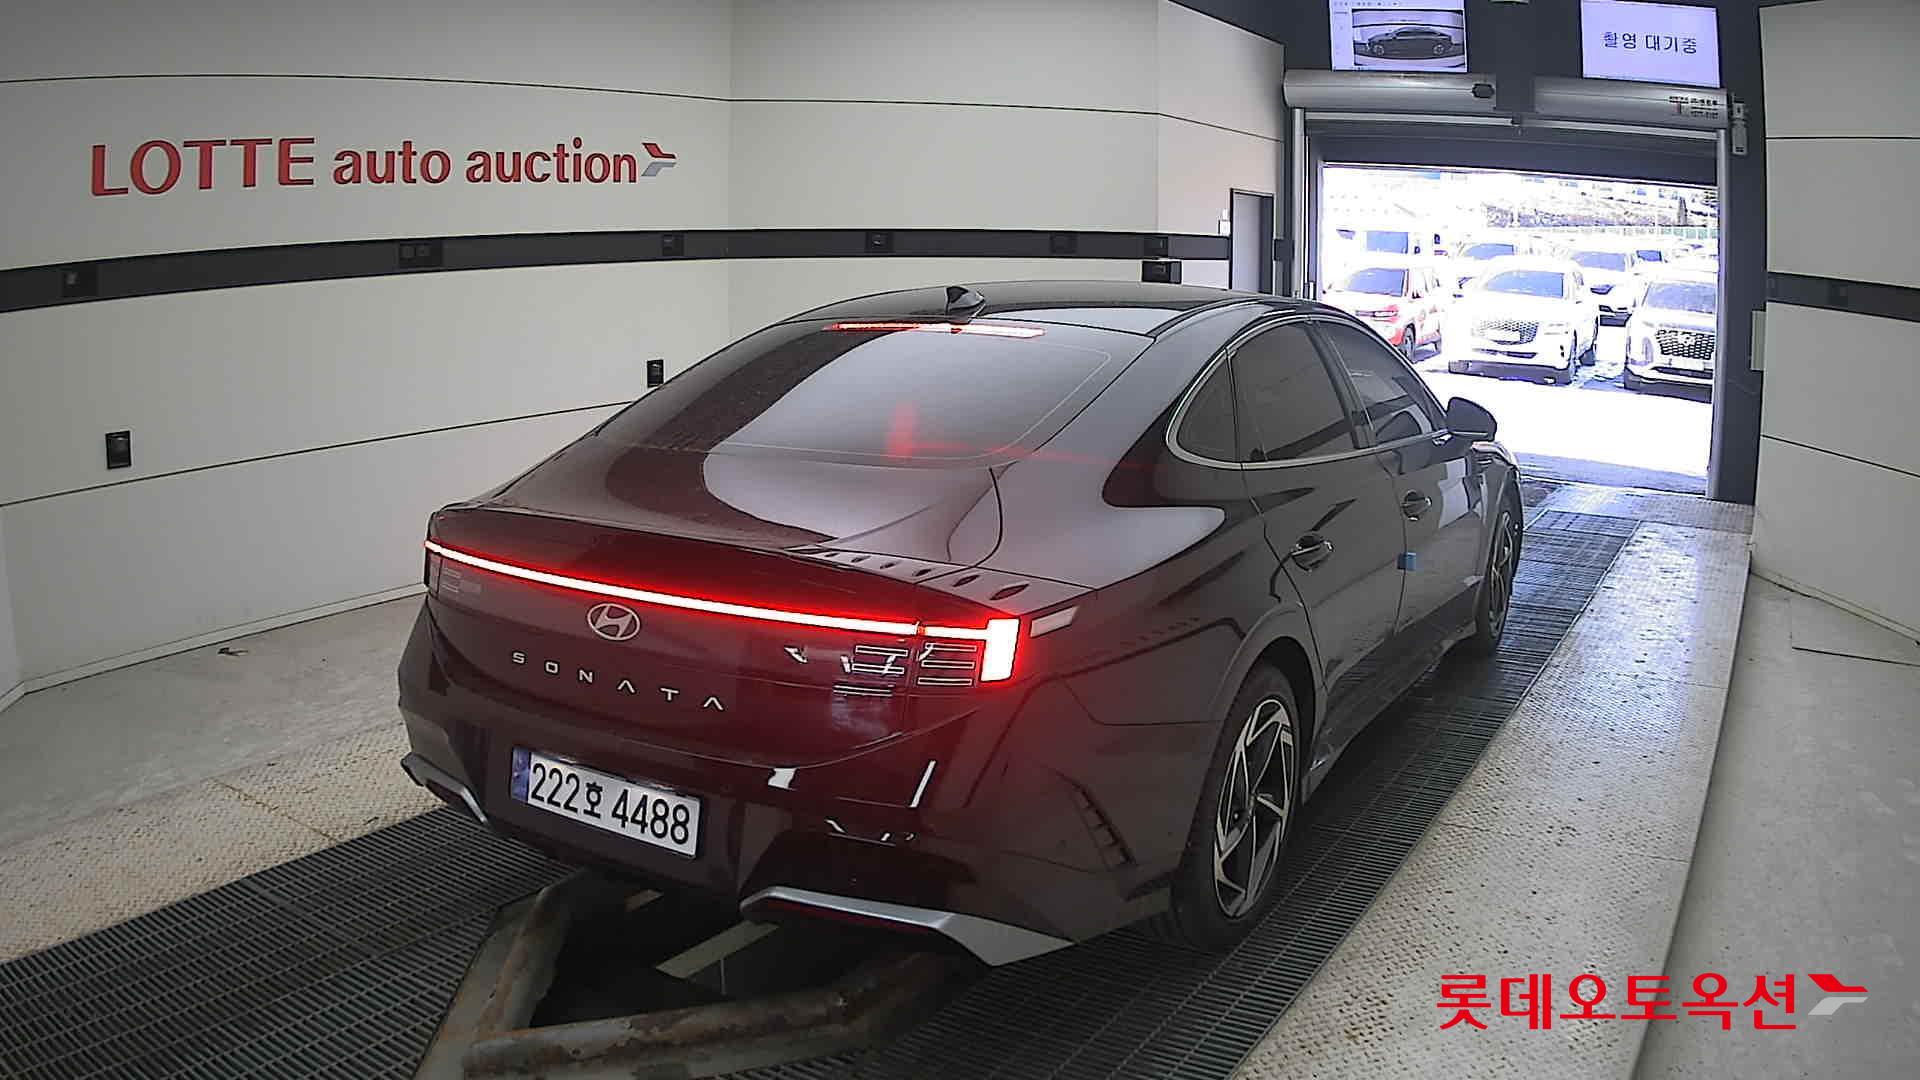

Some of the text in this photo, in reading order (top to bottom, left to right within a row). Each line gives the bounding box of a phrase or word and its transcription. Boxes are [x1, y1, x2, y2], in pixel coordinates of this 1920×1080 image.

[1645, 34, 1697, 54] 대기중
[91, 137, 638, 196] LOTTE auto auction
[512, 651, 725, 711] SONATA
[612, 788, 690, 845] 4488
